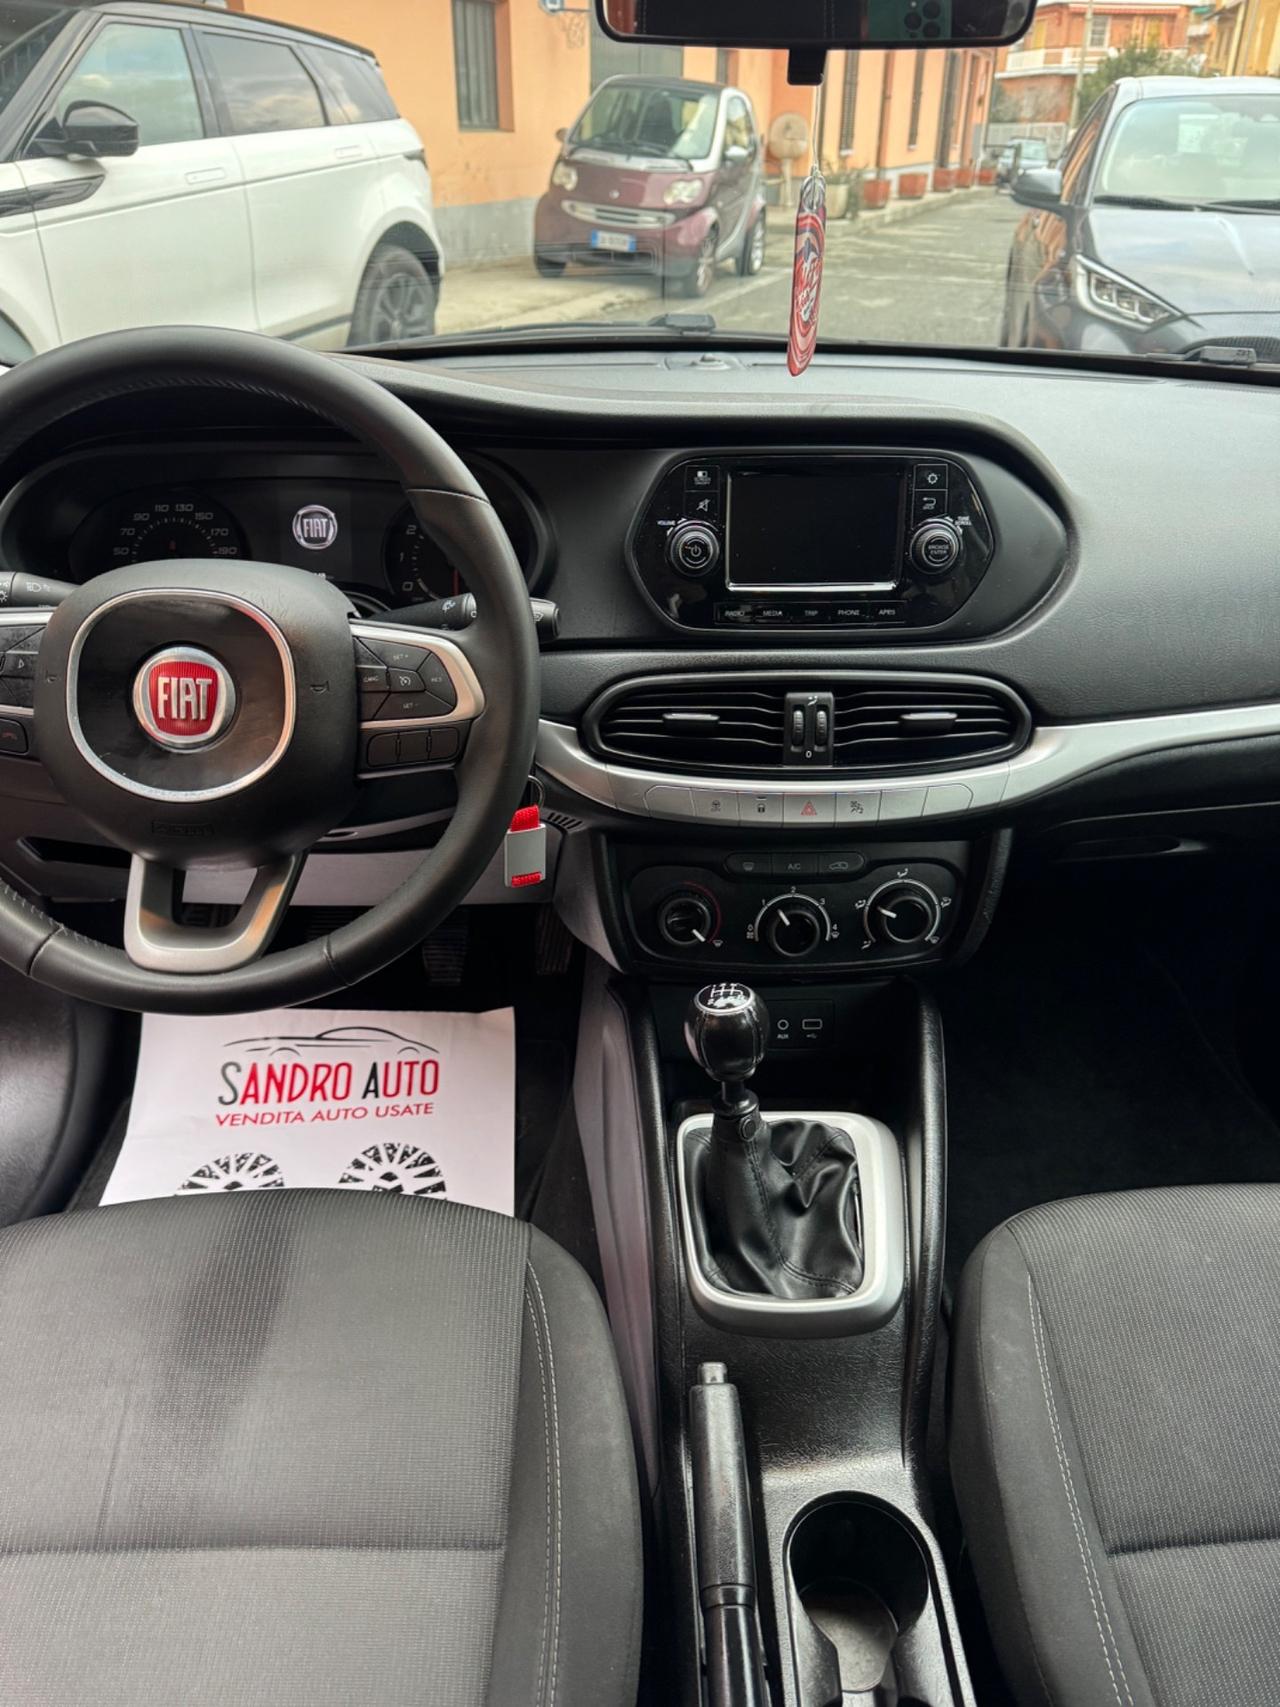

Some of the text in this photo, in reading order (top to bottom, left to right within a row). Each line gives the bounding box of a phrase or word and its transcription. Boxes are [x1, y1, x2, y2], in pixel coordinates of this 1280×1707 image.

[155, 504, 169, 512] 110
[175, 504, 194, 512] 130
[134, 513, 149, 521] 90
[195, 512, 213, 520] 150
[120, 528, 135, 536] 70
[211, 528, 229, 536] 170
[303, 518, 328, 538] FIAT
[406, 524, 417, 535] 2
[113, 547, 129, 555] 50
[219, 547, 237, 555] 190
[400, 552, 404, 561] 1
[402, 581, 413, 591] 0
[725, 609, 745, 617] RADIO
[158, 676, 213, 721] FIAT
[805, 750, 812, 759] 0
[787, 863, 801, 871] A/C
[790, 886, 796, 894] 2
[832, 923, 838, 931] 4
[218, 1059, 439, 1106] SANDRO AUTO
[215, 1102, 434, 1127] VENDITA AUTO USATE
